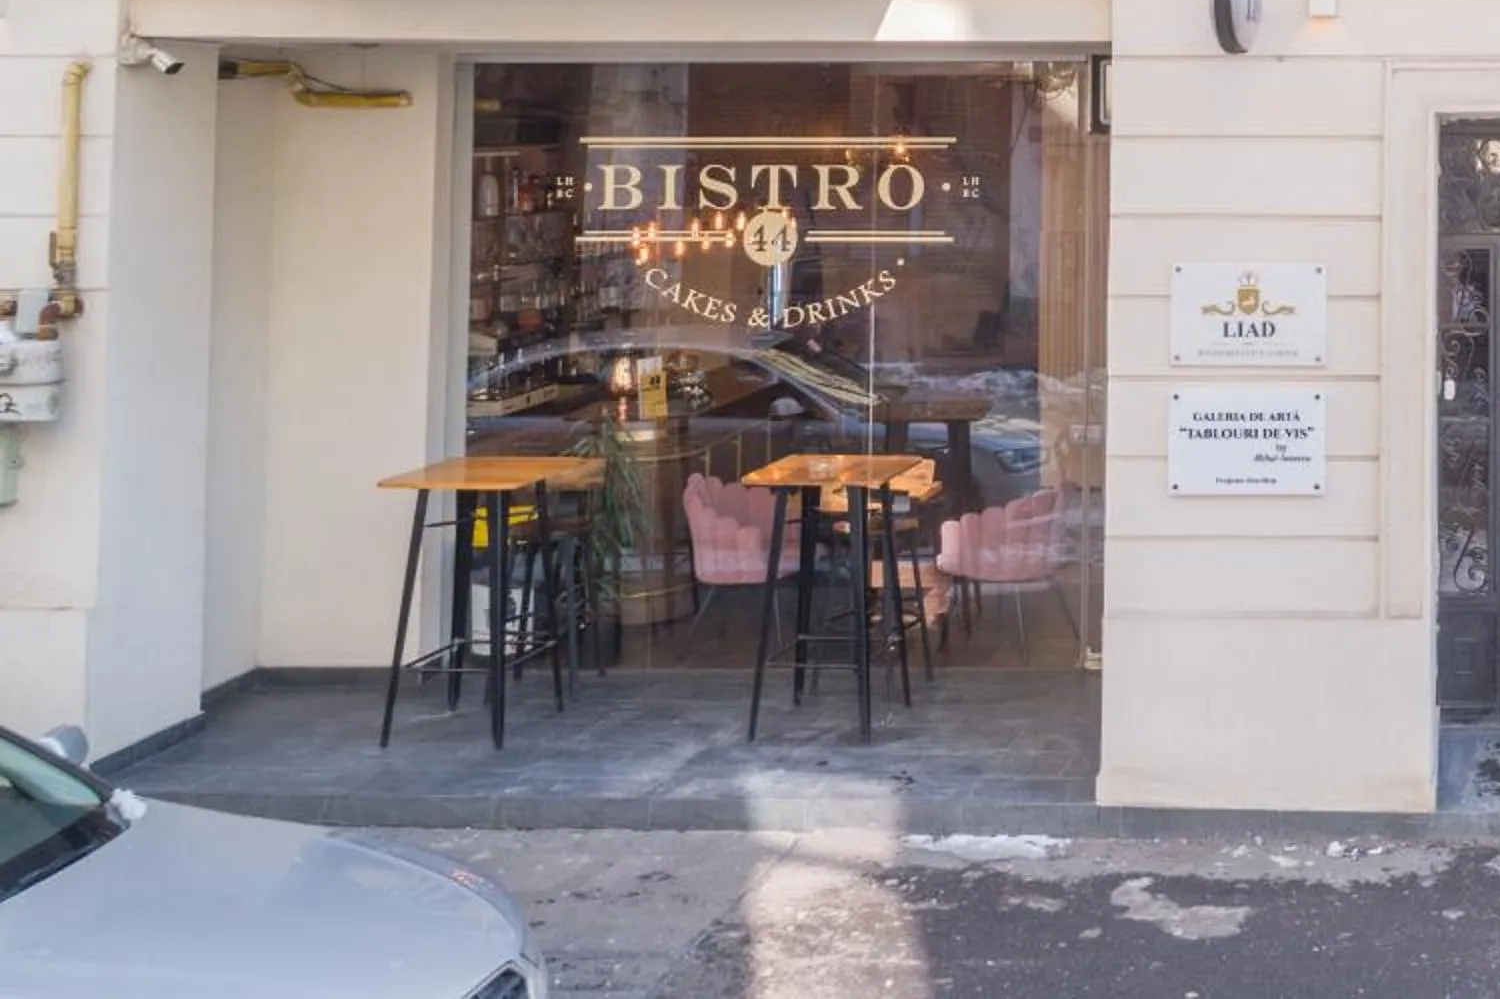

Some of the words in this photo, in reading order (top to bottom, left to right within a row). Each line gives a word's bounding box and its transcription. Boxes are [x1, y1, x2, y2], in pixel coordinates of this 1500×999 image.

[597, 163, 925, 211] BISTRO
[750, 224, 792, 253] 44
[645, 268, 738, 323] CAKES
[748, 305, 770, 329] &
[783, 269, 897, 329] DRINKS
[1222, 321, 1276, 338] LIAD
[1192, 411, 1246, 422] GALERIA
[1249, 412, 1265, 422] DE
[1262, 428, 1282, 440] DE
